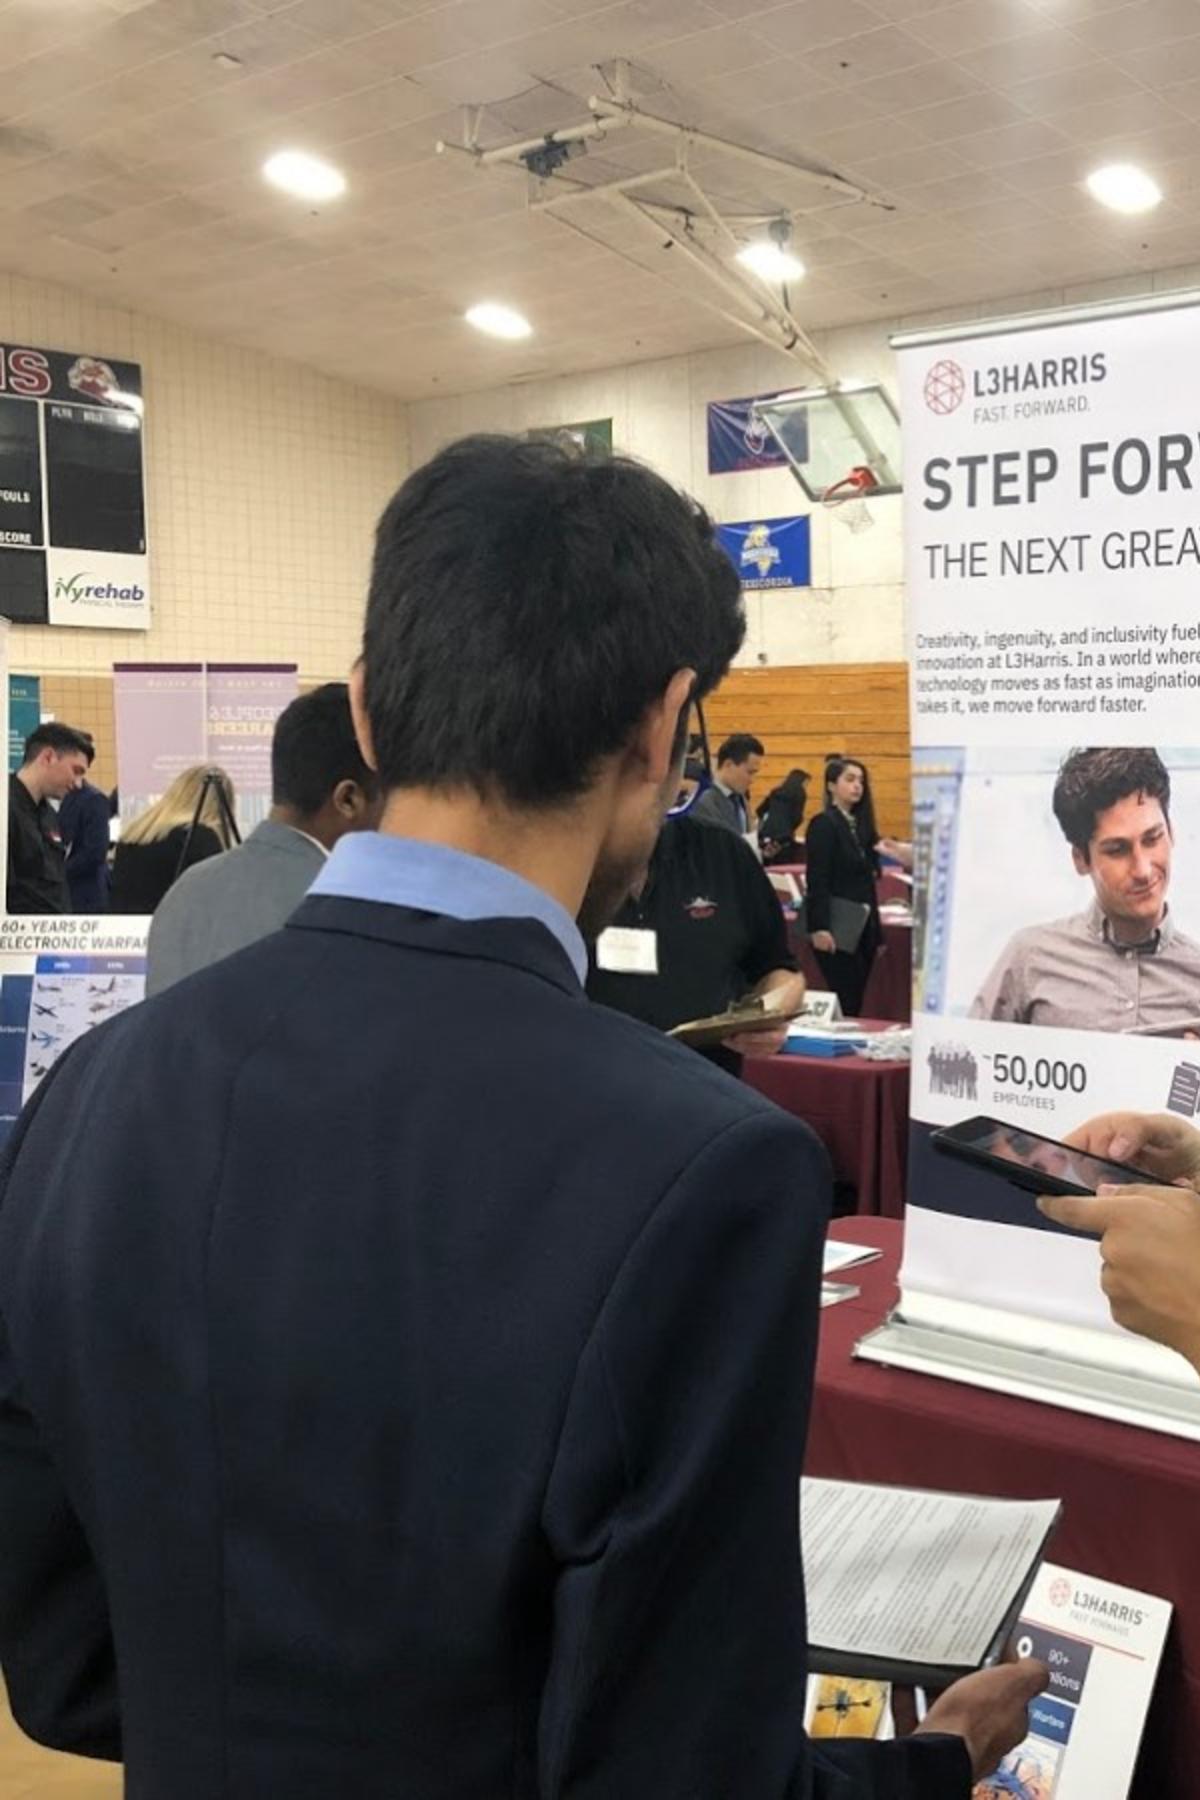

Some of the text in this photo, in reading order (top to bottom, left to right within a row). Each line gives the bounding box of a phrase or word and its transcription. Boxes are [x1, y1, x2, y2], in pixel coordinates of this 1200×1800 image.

[973, 352, 1107, 398] L3HARRIS
[1013, 395, 1091, 419] FORWARD.
[923, 447, 1058, 511] STEP
[923, 541, 988, 580] THE
[1000, 533, 1092, 577] NEXT
[984, 629, 1056, 650] ingenuity,
[1060, 627, 1088, 645] and
[1091, 625, 1168, 645] inclusivity
[987, 655, 1002, 669] at
[1005, 651, 1073, 669] L3Harris.
[1077, 651, 1093, 667] In
[1096, 653, 1106, 667] a
[1109, 648, 1152, 666] world
[991, 677, 1040, 691] moves
[1043, 677, 1061, 690] as
[1064, 673, 1092, 690] fast
[1095, 676, 1113, 689] as
[967, 700, 989, 713] we
[993, 700, 1033, 713] move
[1037, 696, 1096, 713] forward
[1100, 695, 1147, 713] faster.
[1, 920, 100, 934] 60+ YEARS OF
[0, 935, 87, 950] ELECTRONIC
[993, 1091, 1056, 1111] EMPLOYEES
[1073, 1591, 1143, 1626] L3HARRIS
